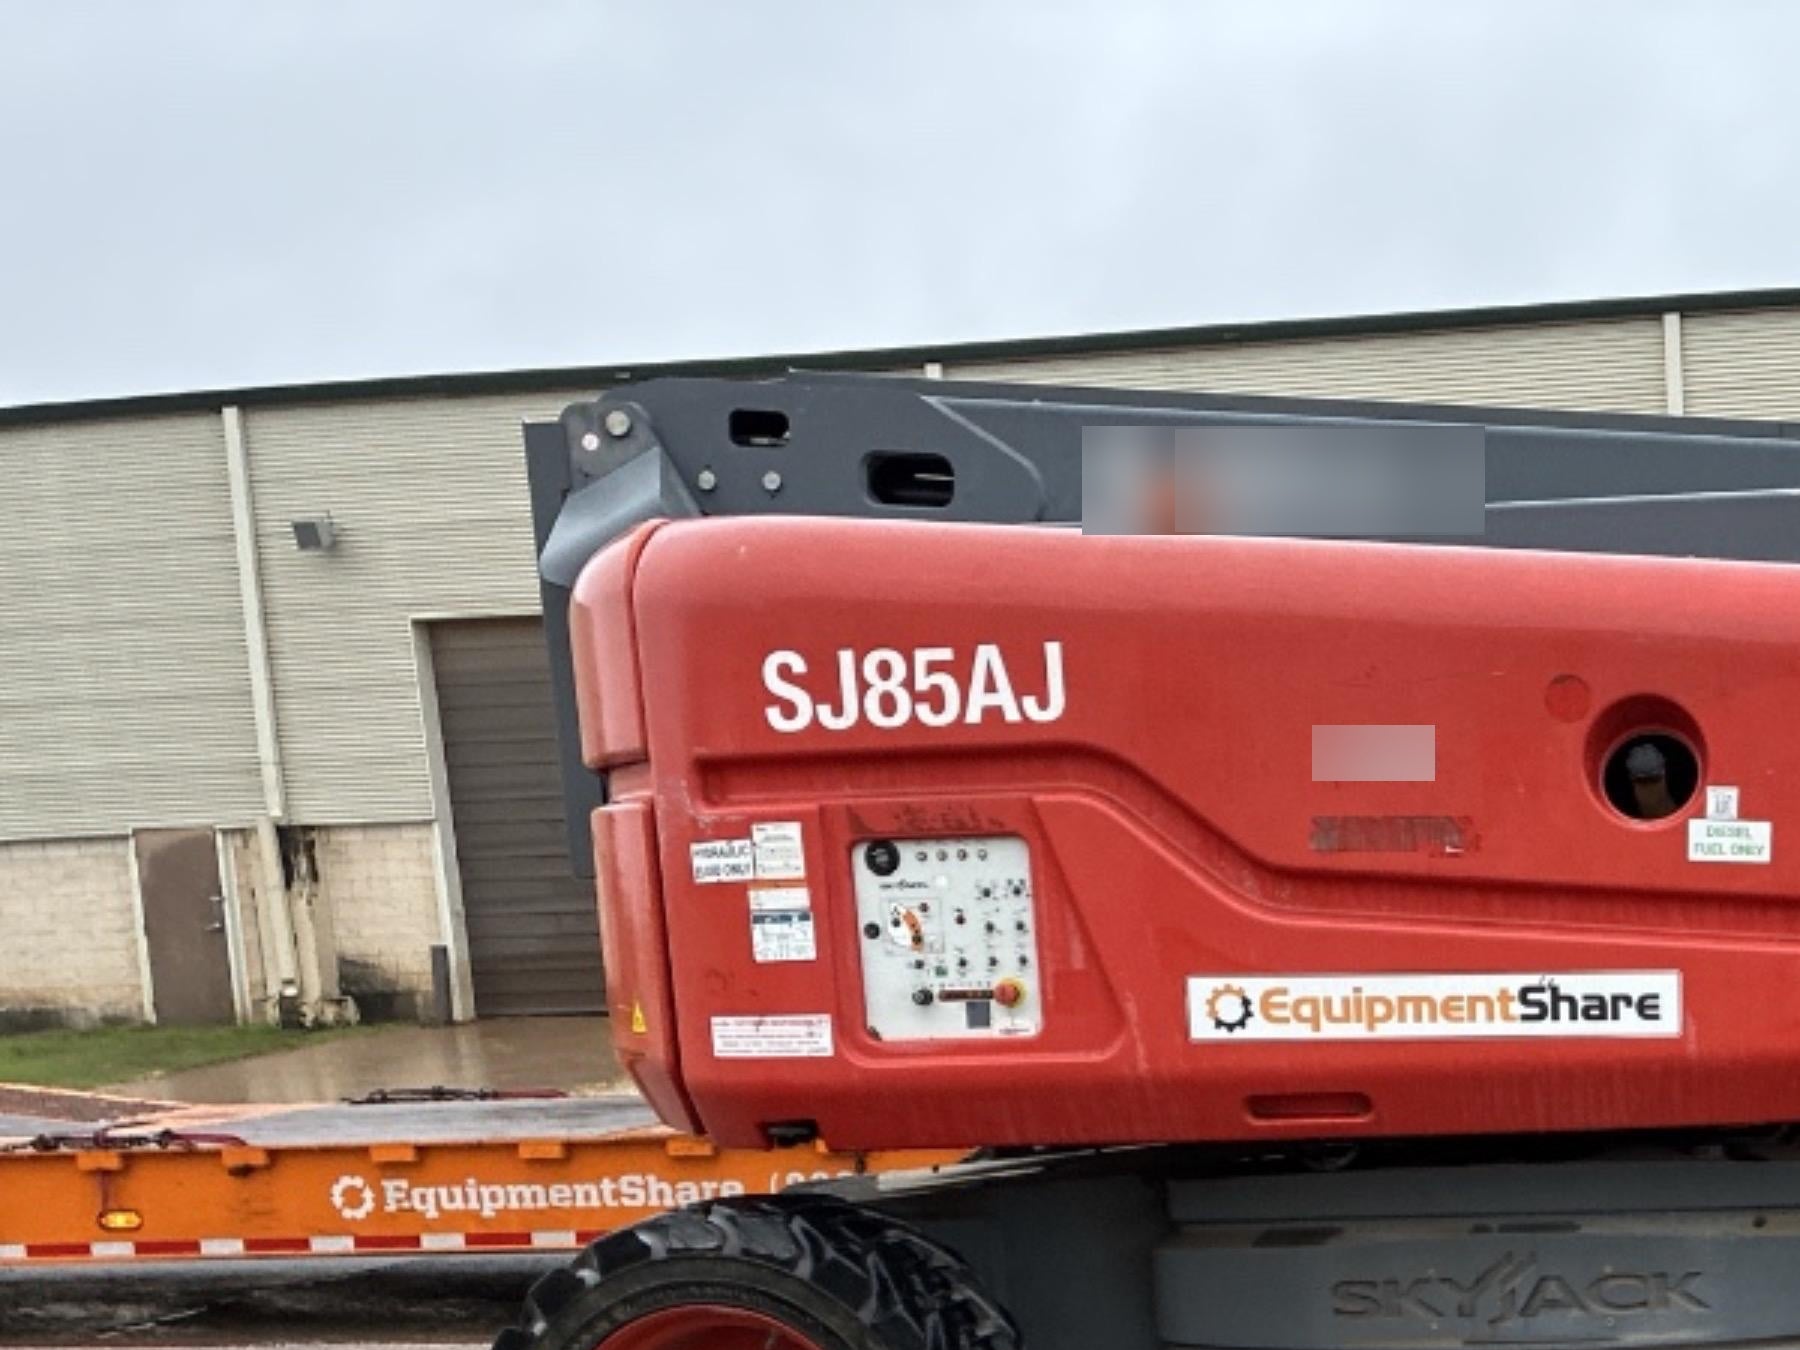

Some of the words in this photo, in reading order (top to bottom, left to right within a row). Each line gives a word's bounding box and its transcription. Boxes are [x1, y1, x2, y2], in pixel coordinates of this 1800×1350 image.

[761, 641, 1066, 732] SJ85AJ
[1259, 985, 1661, 1032] EquipmentShare
[381, 1174, 745, 1219] EquipmentShare
[1331, 1252, 1712, 1325] SKYJACK
